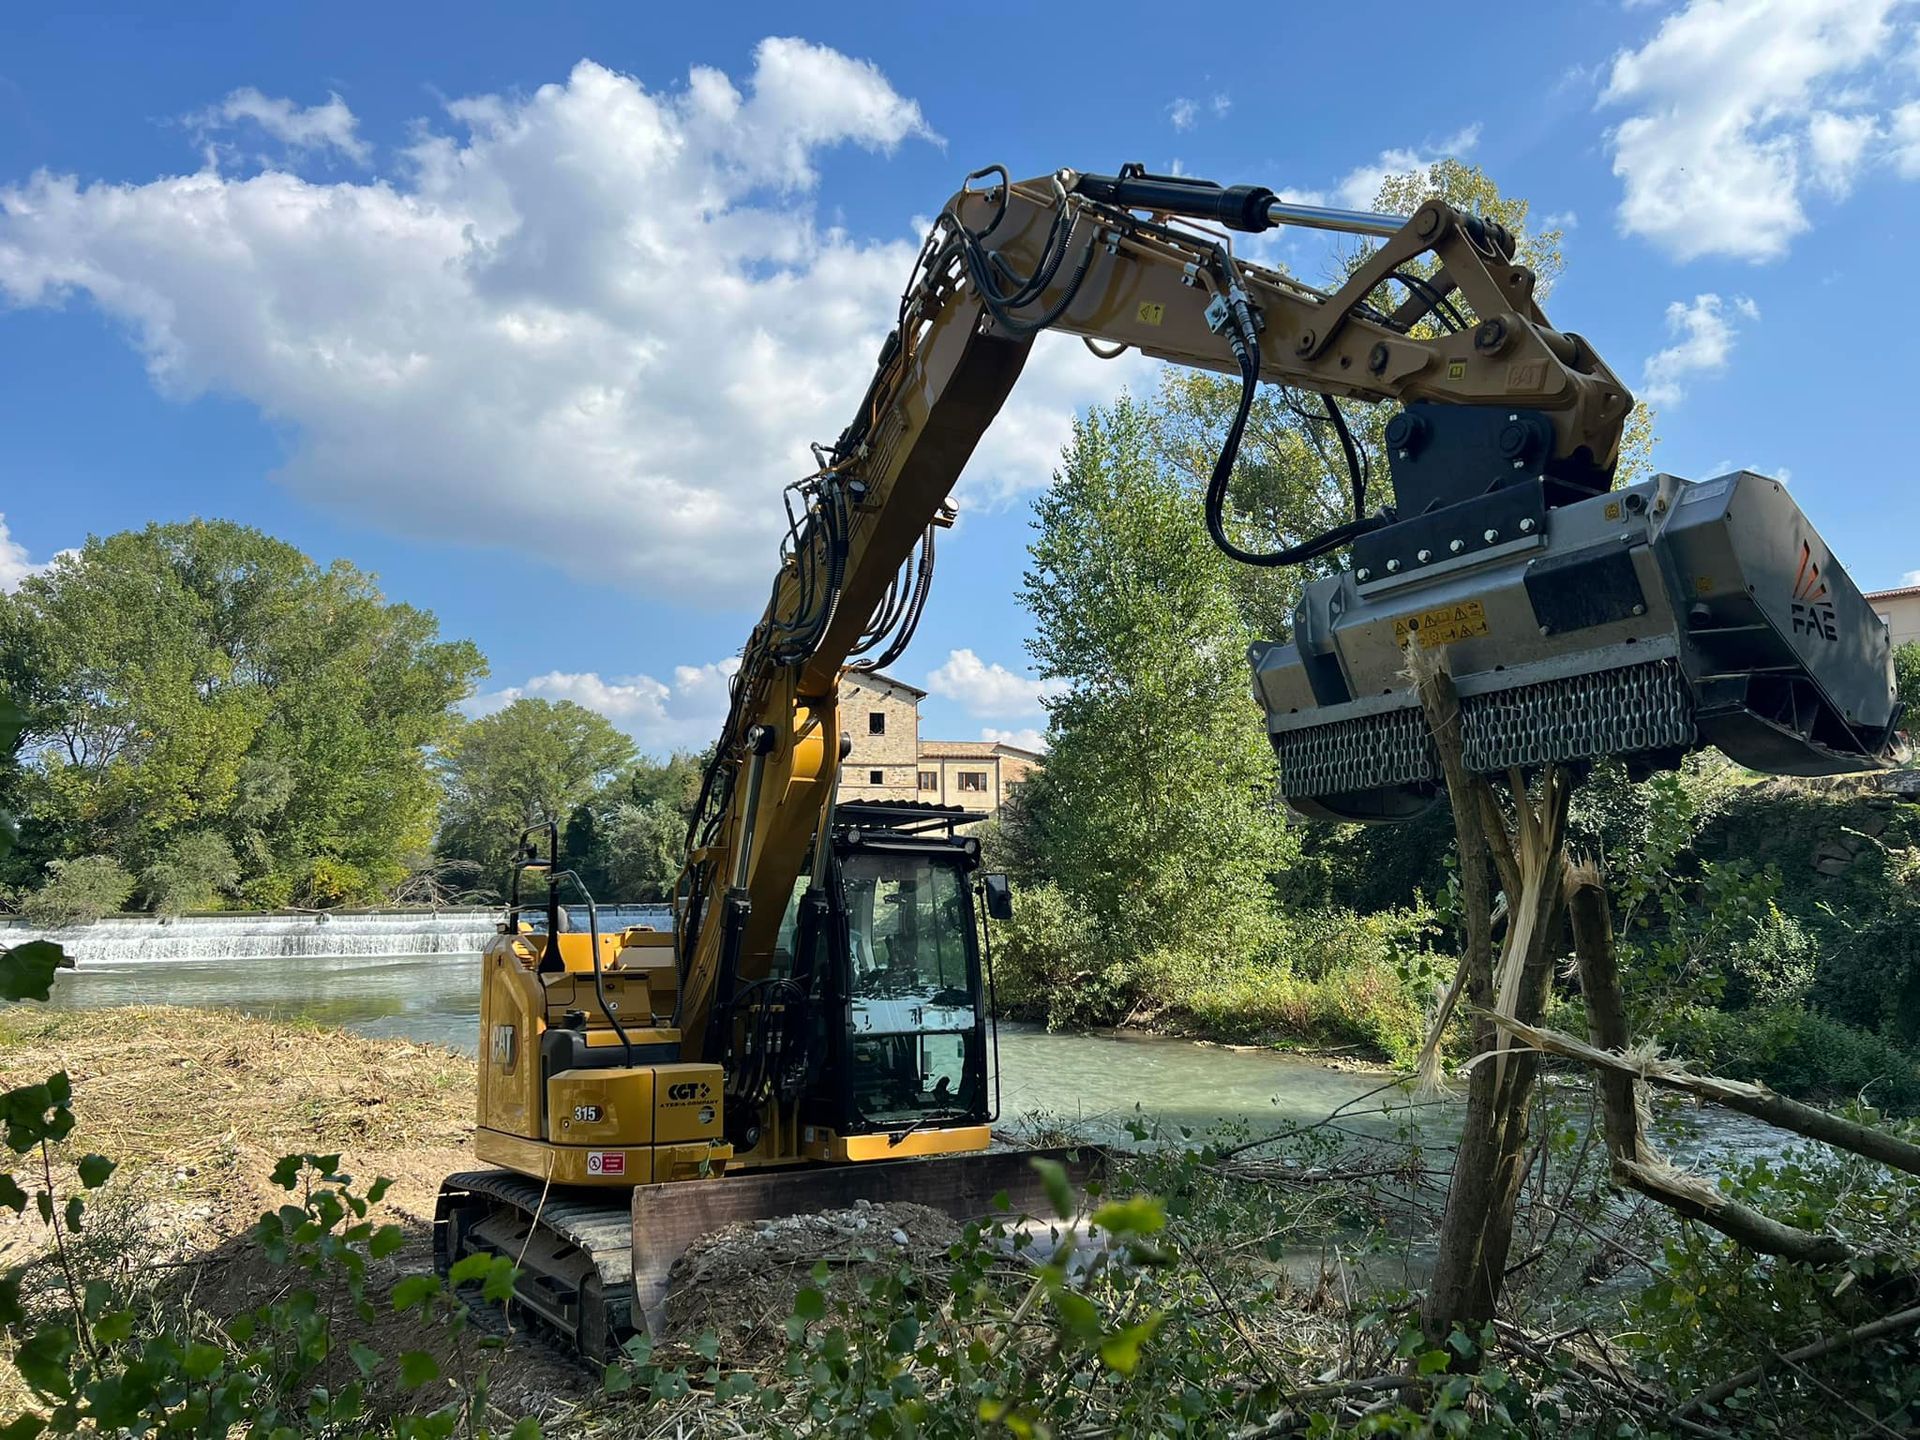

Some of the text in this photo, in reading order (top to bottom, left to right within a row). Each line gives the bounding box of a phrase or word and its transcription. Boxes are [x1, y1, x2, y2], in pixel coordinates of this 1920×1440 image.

[1791, 603, 1838, 641] FAE
[492, 1025, 513, 1063] CAT
[669, 1083, 698, 1100] CGT
[575, 1106, 596, 1121] 315
